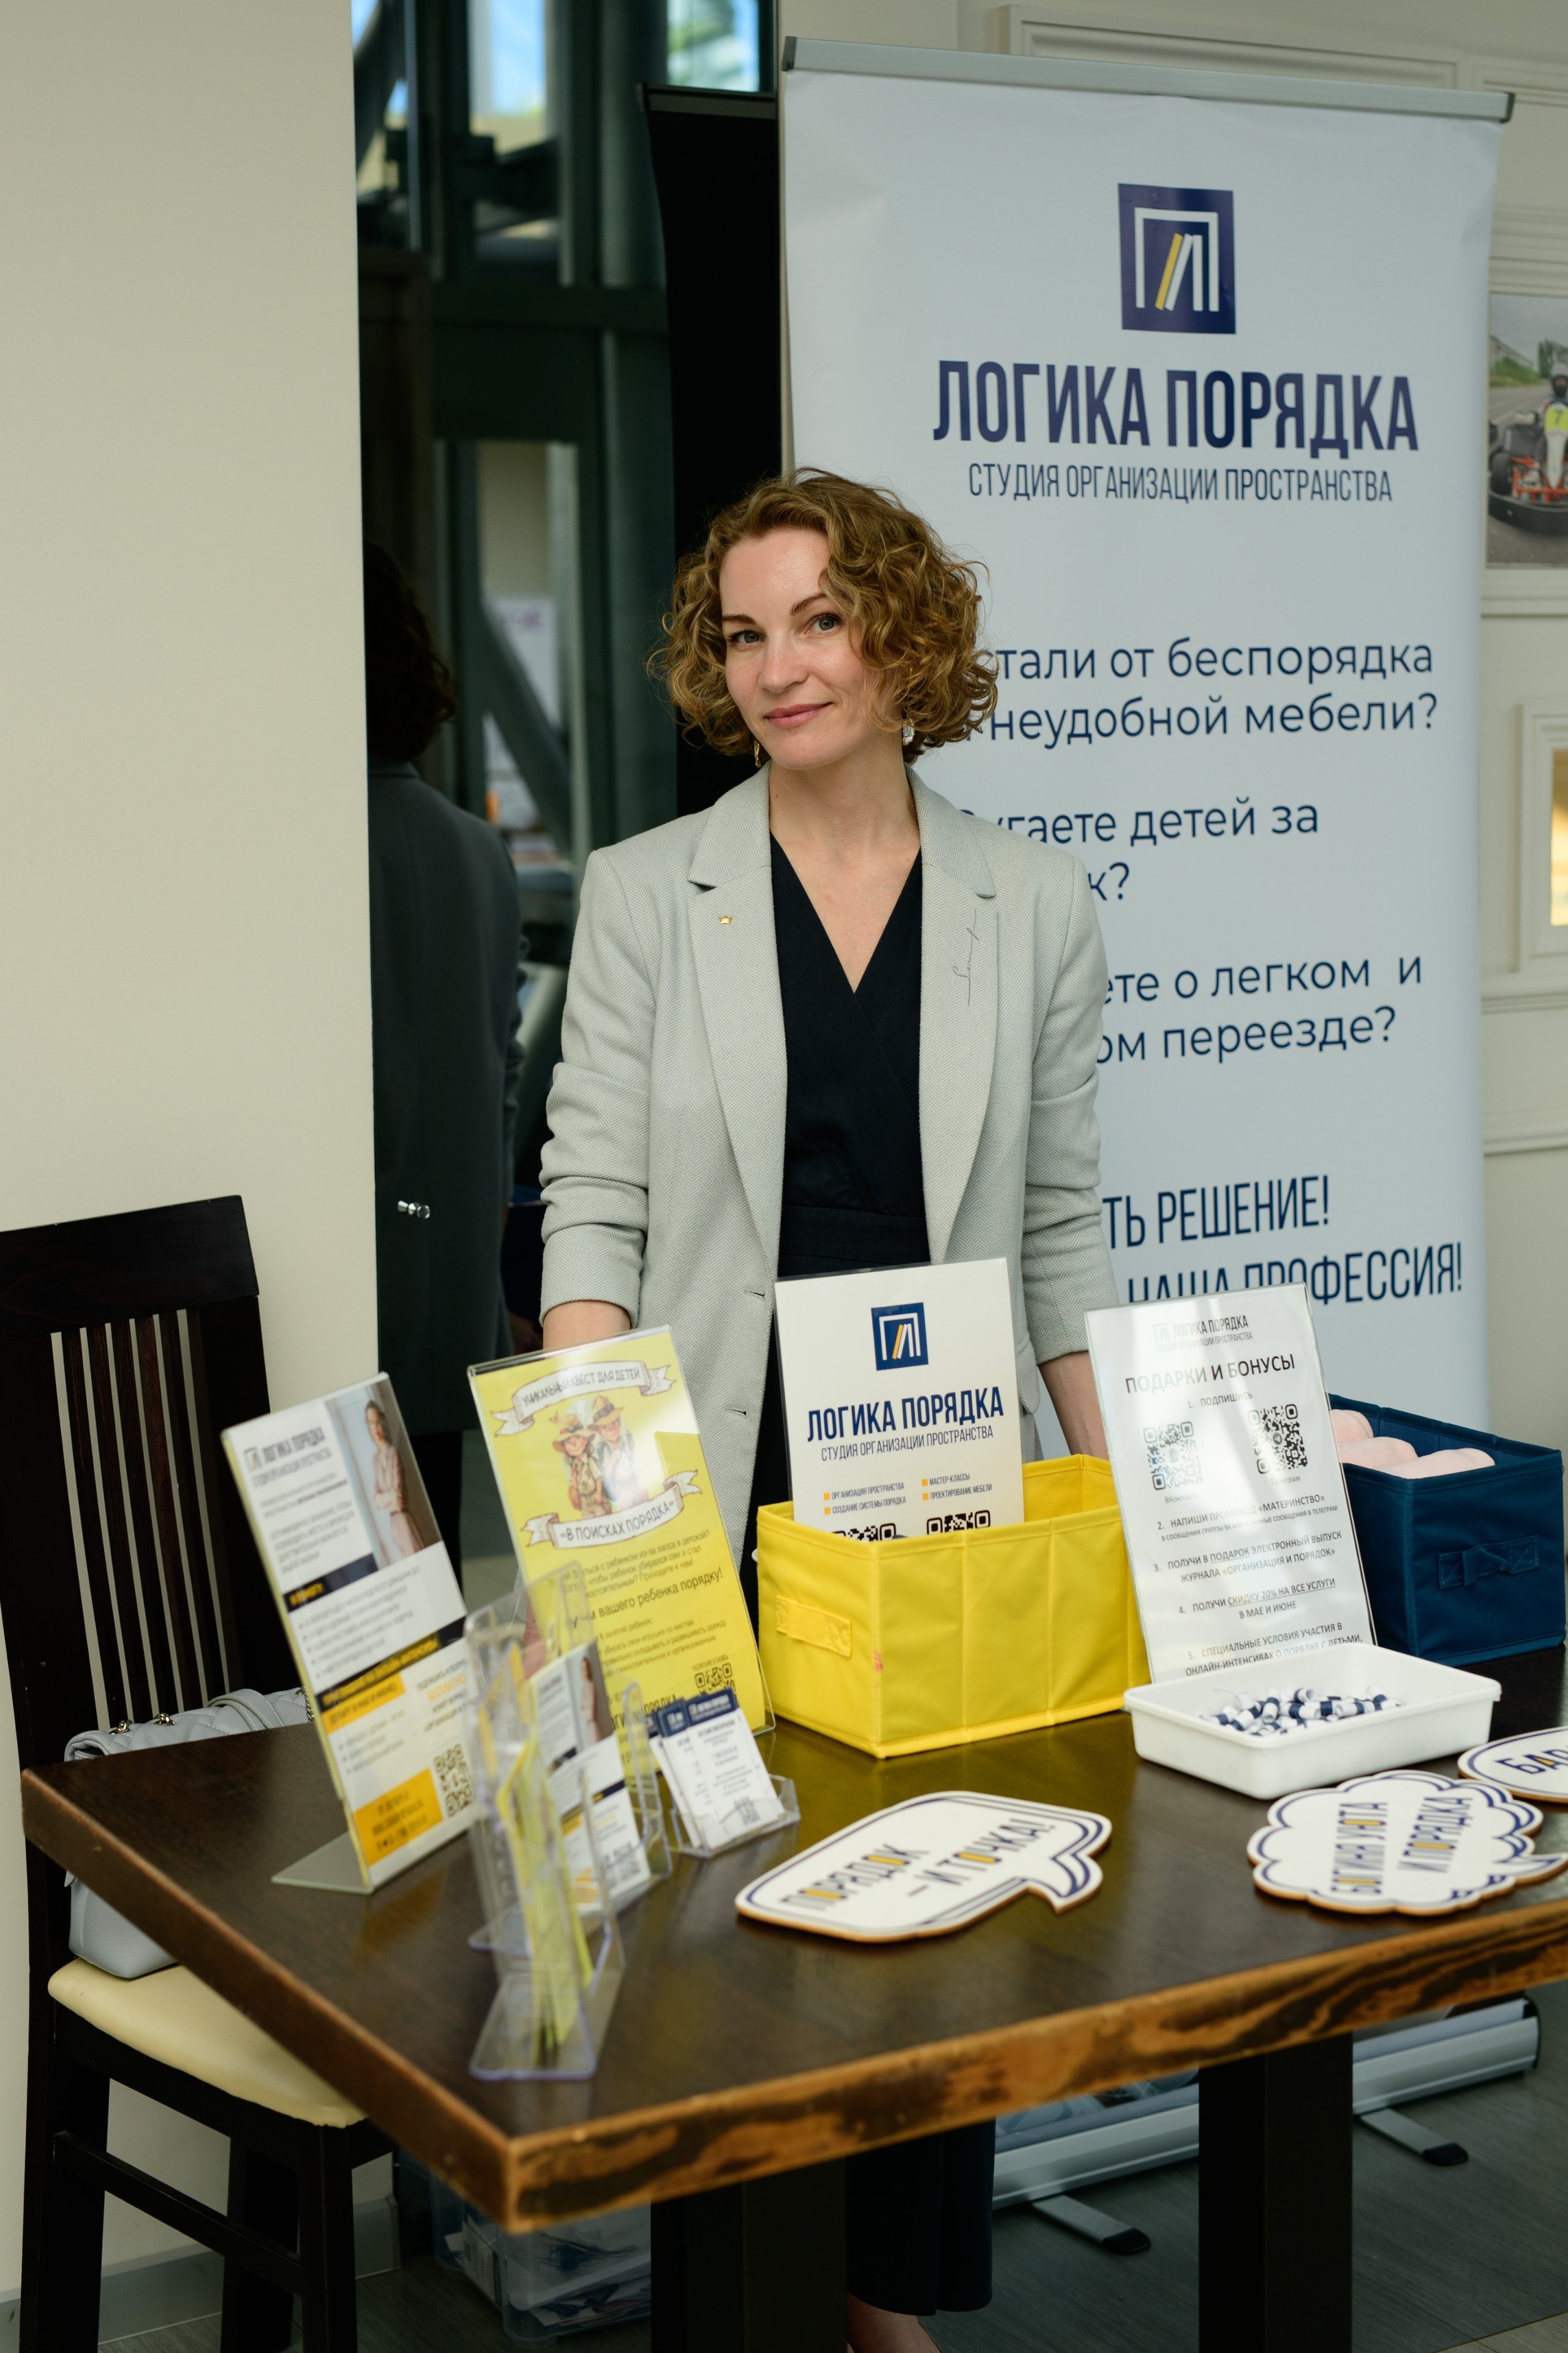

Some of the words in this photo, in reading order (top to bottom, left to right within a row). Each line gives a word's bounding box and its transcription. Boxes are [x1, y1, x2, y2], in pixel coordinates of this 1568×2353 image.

[933, 360, 1150, 446] ЛОГИКА
[1167, 369, 1419, 459] ПОРЯДКА
[968, 463, 1059, 500] СТУДИЯ
[1066, 465, 1218, 504] ОРГАНИЗАЦИИ
[1226, 469, 1392, 501] ПРОСТРАНСТВА
[985, 647, 1095, 680] тали
[1110, 648, 1153, 678] от
[1168, 637, 1433, 684] беспорядка
[990, 695, 1227, 749] неудобной
[1245, 693, 1437, 734] мебели?
[1130, 797, 1255, 847] детей
[1272, 804, 1318, 834] за
[1174, 970, 1198, 999] о
[1211, 959, 1370, 997] легком
[1398, 956, 1422, 985] и
[1164, 1005, 1396, 1064] переезде?
[1102, 1195, 1147, 1249] ТЬ
[1158, 1174, 1329, 1244] РЕШЕНИЕ!
[1208, 1315, 1248, 1334] ПОРЯДКА
[1215, 1331, 1253, 1345] ПРОСТРАНСТВА
[571, 1372, 595, 1386] КВЕСТ
[597, 1371, 613, 1383] ДЛЯ
[615, 1367, 641, 1381] ДЕТЕЙ
[1125, 1367, 1207, 1394] ПОДАРКИ
[1211, 1364, 1224, 1381] И
[1227, 1354, 1295, 1379] БОНУСЫ
[807, 1400, 896, 1442] ЛОГИКА
[902, 1386, 1004, 1429] ПОРЯДКА
[1200, 1391, 1253, 1408] ПОДПИШИСЬ
[821, 1443, 858, 1461] СТУДИЯ
[860, 1435, 925, 1456] ОРГАНИЗАЦИИ
[927, 1425, 993, 1446] ПРОСТРАНСТВА
[831, 1488, 867, 1500] ОРГАНИЗАЦИЯ
[867, 1482, 905, 1494] ПРОСТРАНСТВА
[929, 1473, 970, 1486] МАСТЕР-КЛАССЫ
[930, 1487, 972, 1500] ПРОЕКТИРОВАНИЕ
[973, 1484, 992, 1494] МЕБЕЛИ
[1270, 1475, 1301, 1486] Телеграм
[832, 1503, 858, 1514] СОЗДАНИЕ
[859, 1500, 883, 1510] СИСТЕМЫ
[883, 1497, 907, 1506] ПОРЯДКА
[1157, 1522, 1165, 1530] 2.
[1170, 1513, 1208, 1528] НАПИШИ
[1210, 1506, 1257, 1521] ПРОМОКОД
[1258, 1494, 1325, 1513] «МАТЕРИНСТВО»
[1164, 1494, 1198, 1504] ВКонтакте
[576, 1524, 624, 1541] ПОИСКАХ
[626, 1500, 674, 1533] ПОРЯДКА»
[682, 1530, 709, 1546] детской?
[1166, 1528, 1200, 1541] СООБЩЕНИЯ
[1201, 1525, 1224, 1535] ГРУППЫ
[1273, 1510, 1307, 1522] СООБЩЕНИЯ
[1313, 1505, 1338, 1515] ТЕЛЕГРАМ
[1167, 1556, 1202, 1569] ПОЛУЧИ
[1203, 1555, 1208, 1563] В
[1210, 1548, 1250, 1562] ПОДАРОК
[1251, 1535, 1310, 1554] ЭЛЕКТРОННЫЙ
[1311, 1531, 1342, 1544] ВЫПУСК
[1180, 1569, 1221, 1583] ЖУРНАЛА
[1223, 1557, 1284, 1575] «ОРГАНИЗАЦИЯ
[1286, 1555, 1292, 1564] И
[1294, 1547, 1335, 1563] ПОРЯДОК»
[598, 1596, 635, 1617] вашего
[638, 1582, 679, 1607] ребенка
[680, 1566, 723, 1592] порядку!
[1193, 1598, 1226, 1612] ПОЛУЧИ
[1227, 1592, 1259, 1606] СКИДКУ
[1262, 1589, 1277, 1600] 20%
[1278, 1587, 1290, 1596] НА
[1291, 1584, 1305, 1593] ВСЕ
[1306, 1577, 1336, 1591] УСЛУГИ
[1239, 1611, 1245, 1619] В
[1246, 1607, 1264, 1618] МАЕ
[1265, 1605, 1272, 1614] И
[1273, 1600, 1297, 1612] ИЮНЕ
[1202, 1638, 1261, 1657] СПЕЦИАЛЬНЫЕ
[1262, 1631, 1299, 1645] УСЛОВИЯ
[1300, 1623, 1335, 1637] УЧАСТИЯ
[1186, 1652, 1273, 1676] ОНЛАЙН-ИНТЕНСИВАХ
[1493, 1746, 1568, 1774] БАР
[937, 1818, 1057, 1872] ТОЧКА!
[1402, 1796, 1474, 1860] ПОРЯДКА
[780, 1843, 931, 1911] ПОРЯДОК
